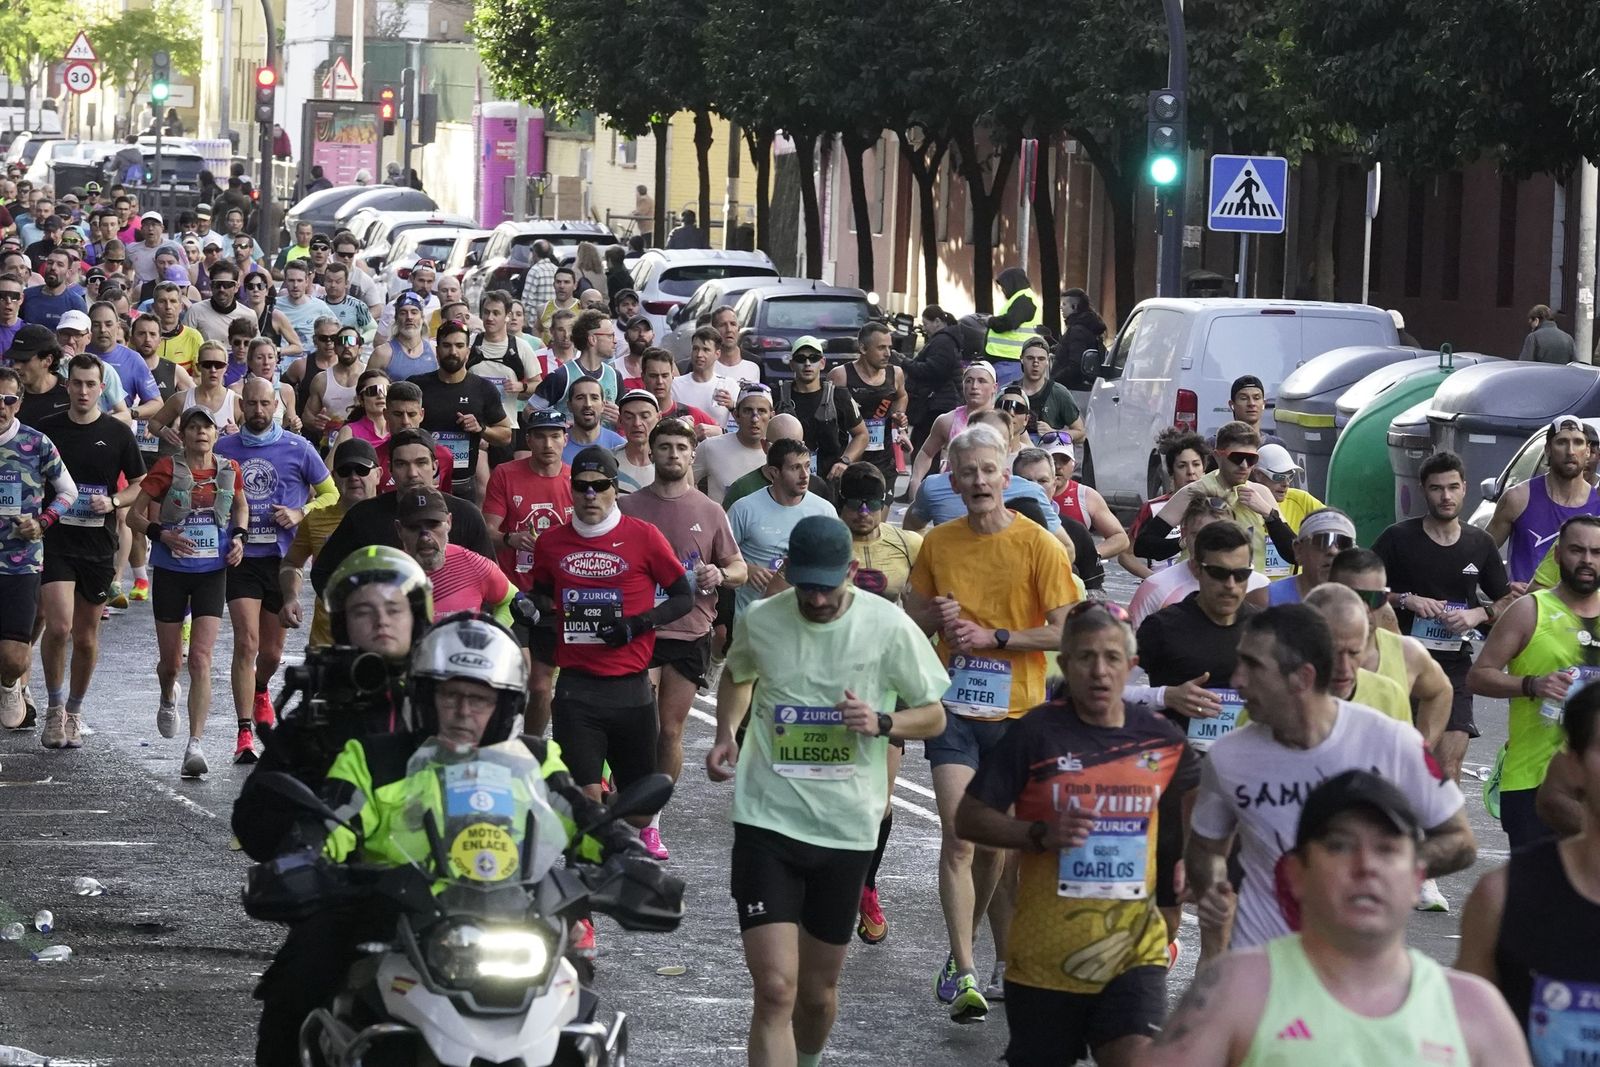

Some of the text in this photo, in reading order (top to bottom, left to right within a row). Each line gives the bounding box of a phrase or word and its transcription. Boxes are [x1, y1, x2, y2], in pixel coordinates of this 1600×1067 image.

[71, 72, 90, 84] 30
[452, 452, 469, 460] ESCO
[78, 486, 104, 494] ZURICH
[417, 495, 427, 506] B
[188, 516, 214, 524] ZURICH
[566, 552, 584, 562] BANK
[594, 552, 620, 564] AMERICA
[569, 564, 617, 576] MARATHON
[573, 559, 613, 570] CHICAGO
[583, 592, 617, 600] ZURICH
[583, 608, 602, 617] 4292
[564, 621, 600, 632] LUCIA Y
[968, 660, 1005, 671] ZURICH
[968, 677, 987, 687] 7064
[956, 687, 995, 704] PETER
[1197, 723, 1217, 736] JM
[780, 746, 850, 762] ILLESCAS
[1094, 820, 1142, 832] ZURICH
[467, 828, 502, 839] MOTO
[462, 840, 508, 852] ENLACE
[1072, 861, 1135, 878] CARLOS
